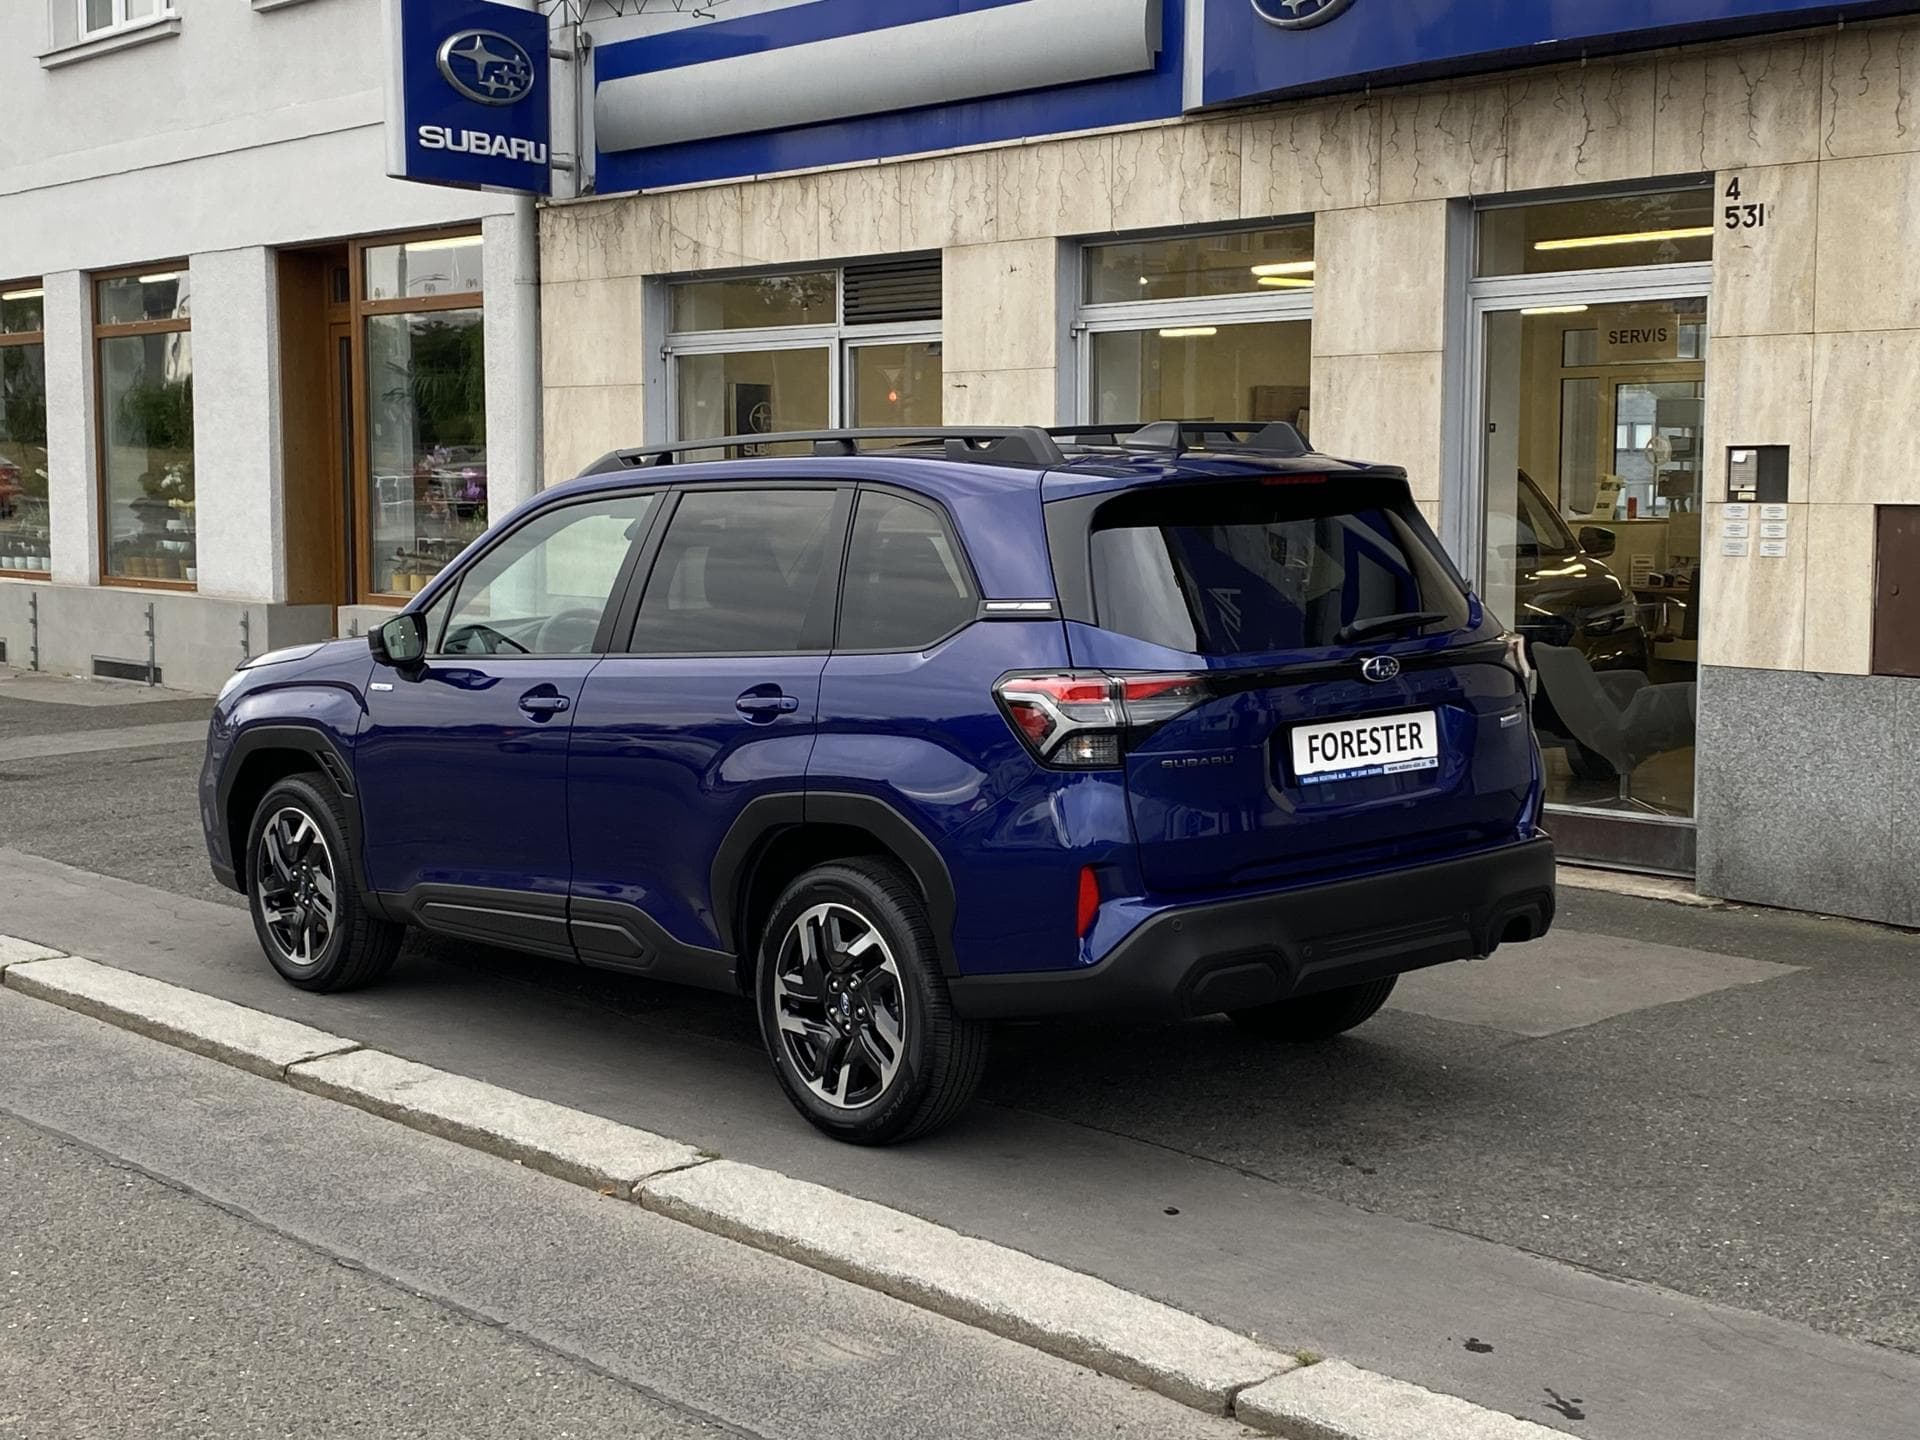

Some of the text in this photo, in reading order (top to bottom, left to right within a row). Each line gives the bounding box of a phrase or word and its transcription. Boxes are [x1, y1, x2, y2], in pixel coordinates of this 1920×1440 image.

[418, 125, 547, 164] SUBARU
[1725, 176, 1741, 200] 4
[1725, 203, 1764, 229] 531
[1608, 327, 1668, 345] SERVIS
[1307, 721, 1424, 764] FORESTER
[1160, 755, 1234, 769] SUBARU
